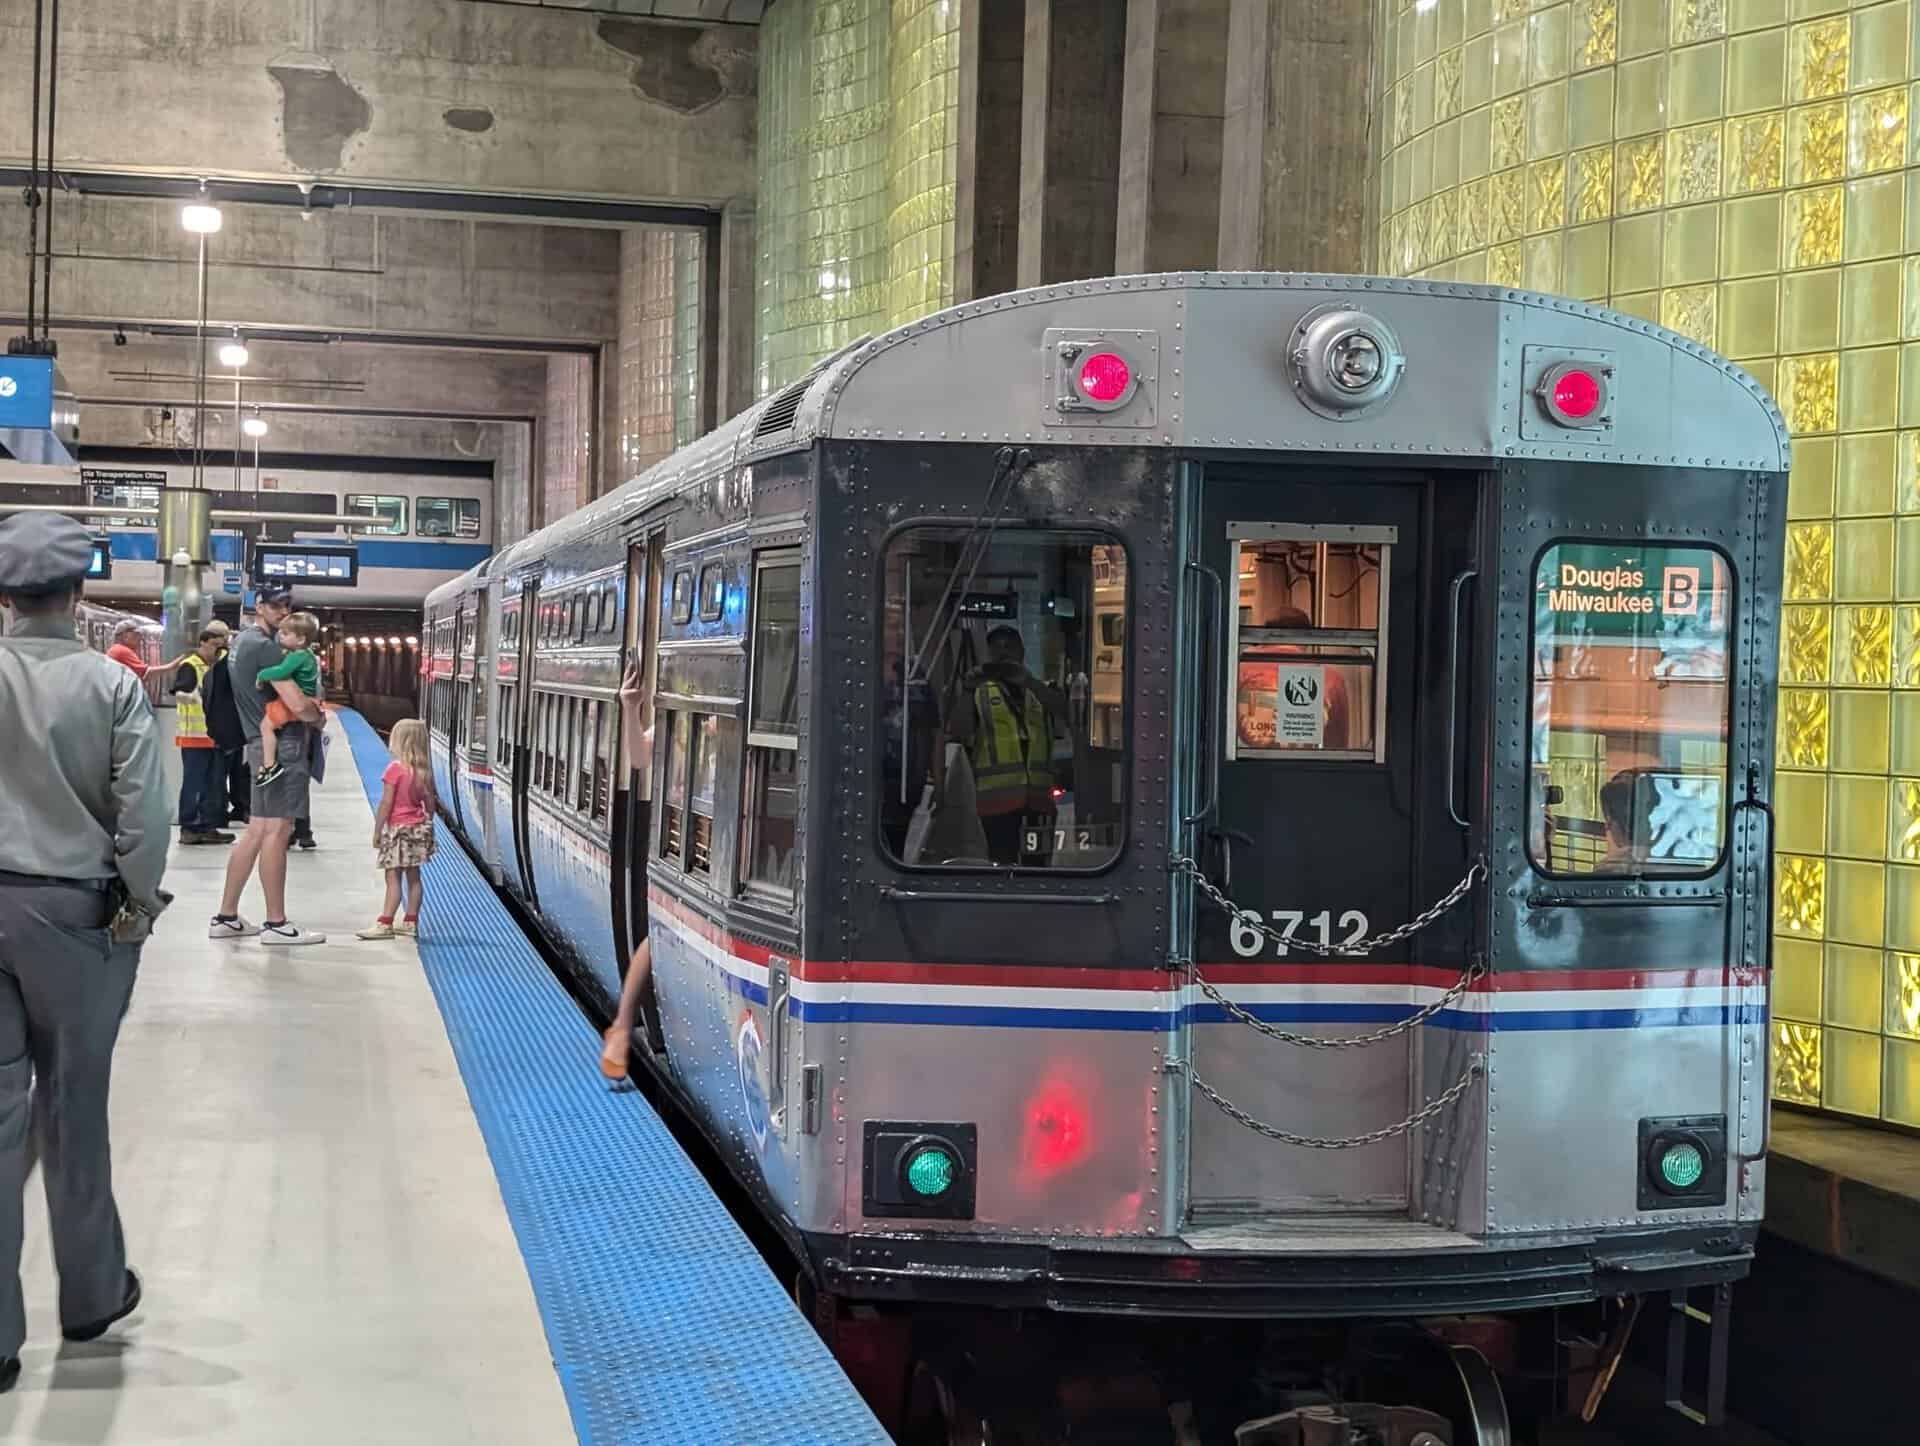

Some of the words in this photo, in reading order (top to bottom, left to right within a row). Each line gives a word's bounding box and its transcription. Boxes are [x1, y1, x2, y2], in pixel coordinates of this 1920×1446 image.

[1561, 564, 1643, 591] Douglas
[1669, 573, 1693, 608] B
[1548, 589, 1653, 613] Milwaukee
[1230, 909, 1369, 957] 6712
